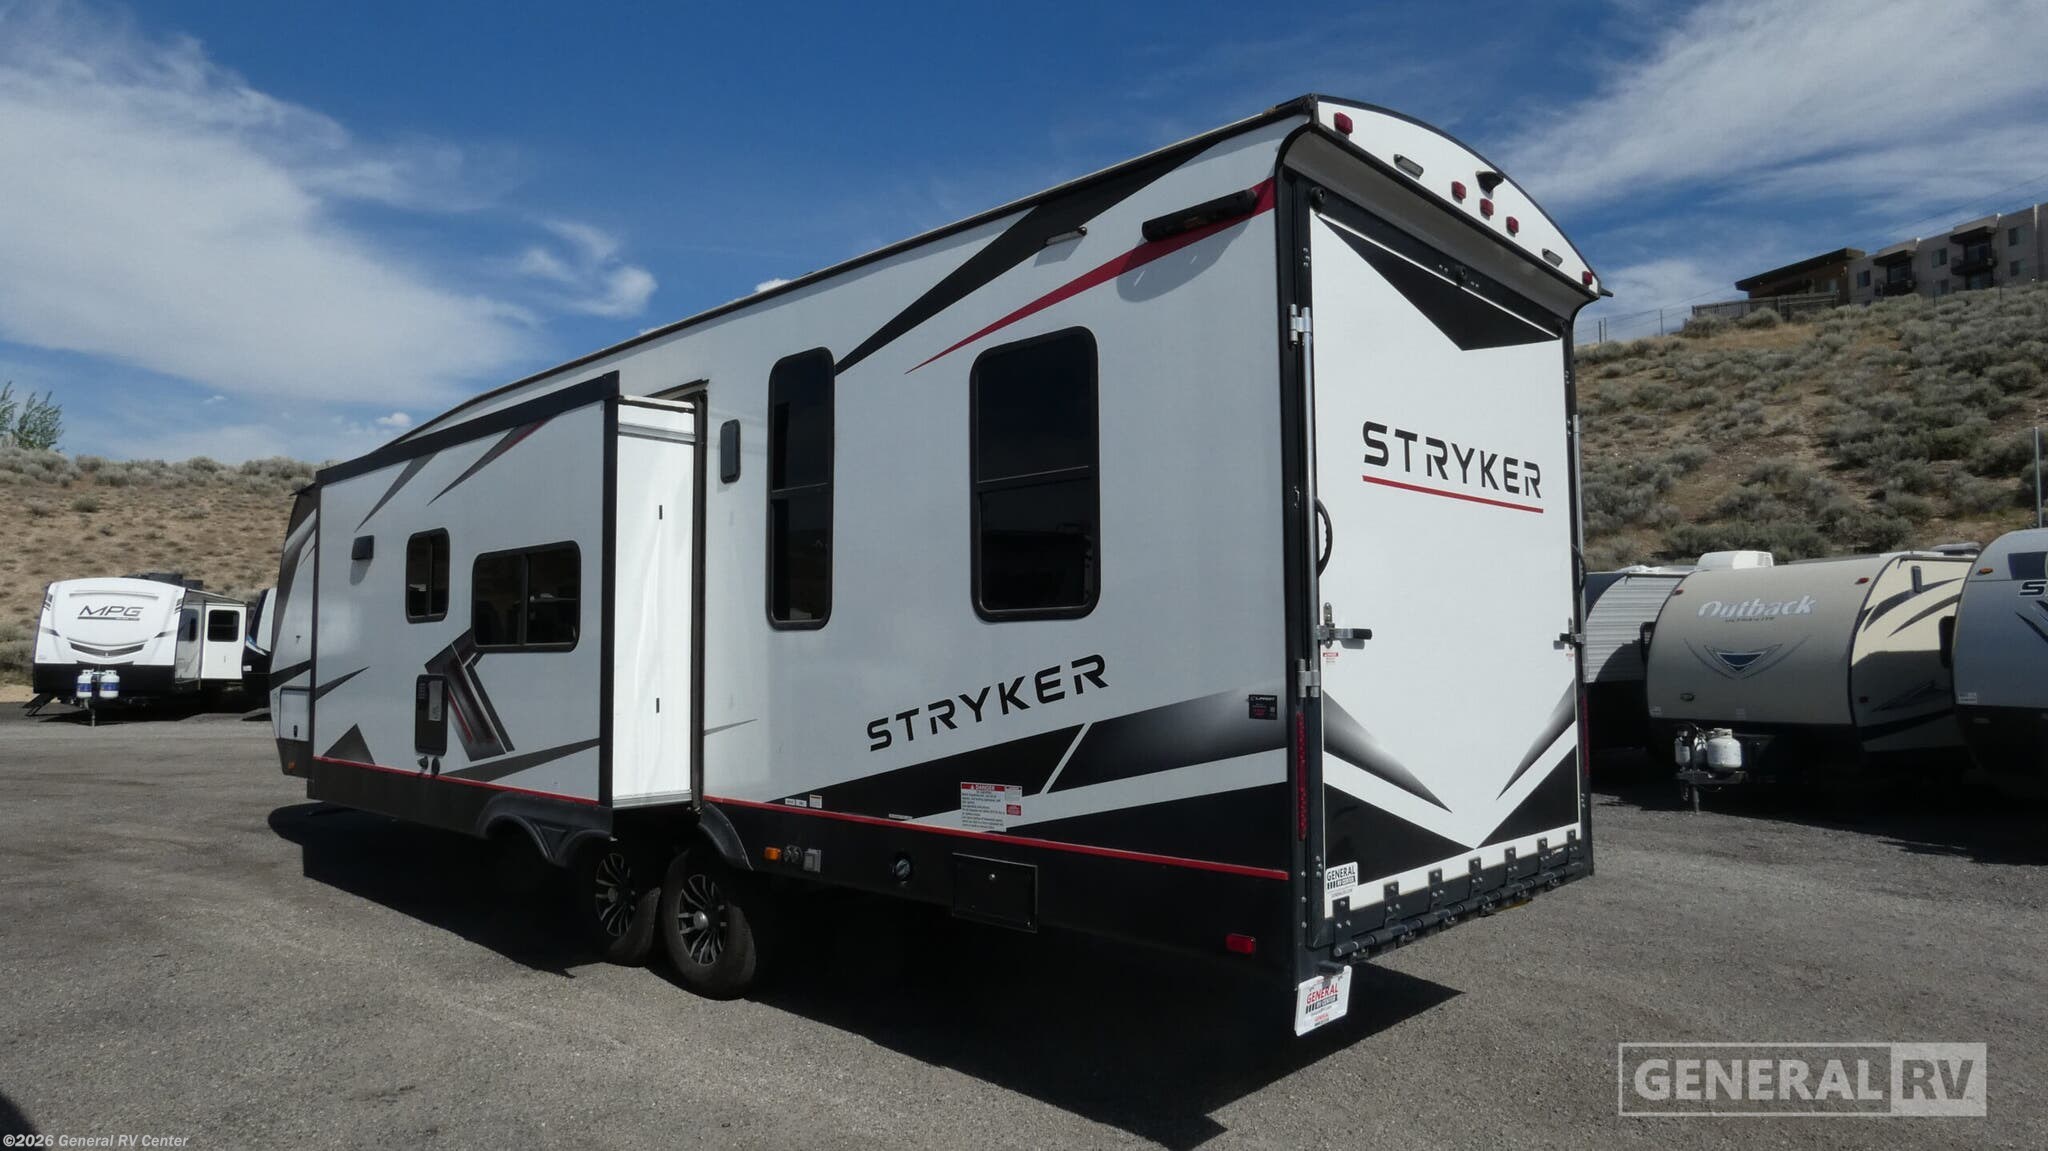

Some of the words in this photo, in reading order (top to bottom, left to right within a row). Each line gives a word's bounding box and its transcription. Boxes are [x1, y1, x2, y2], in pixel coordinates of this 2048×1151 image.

[1362, 420, 1542, 498] STRYKER
[79, 604, 144, 617] MPG
[1697, 594, 1817, 618] Outback
[866, 654, 1109, 752] STRYKER
[1327, 865, 1355, 881] GENERAL
[1306, 983, 1339, 1004] GENERAL
